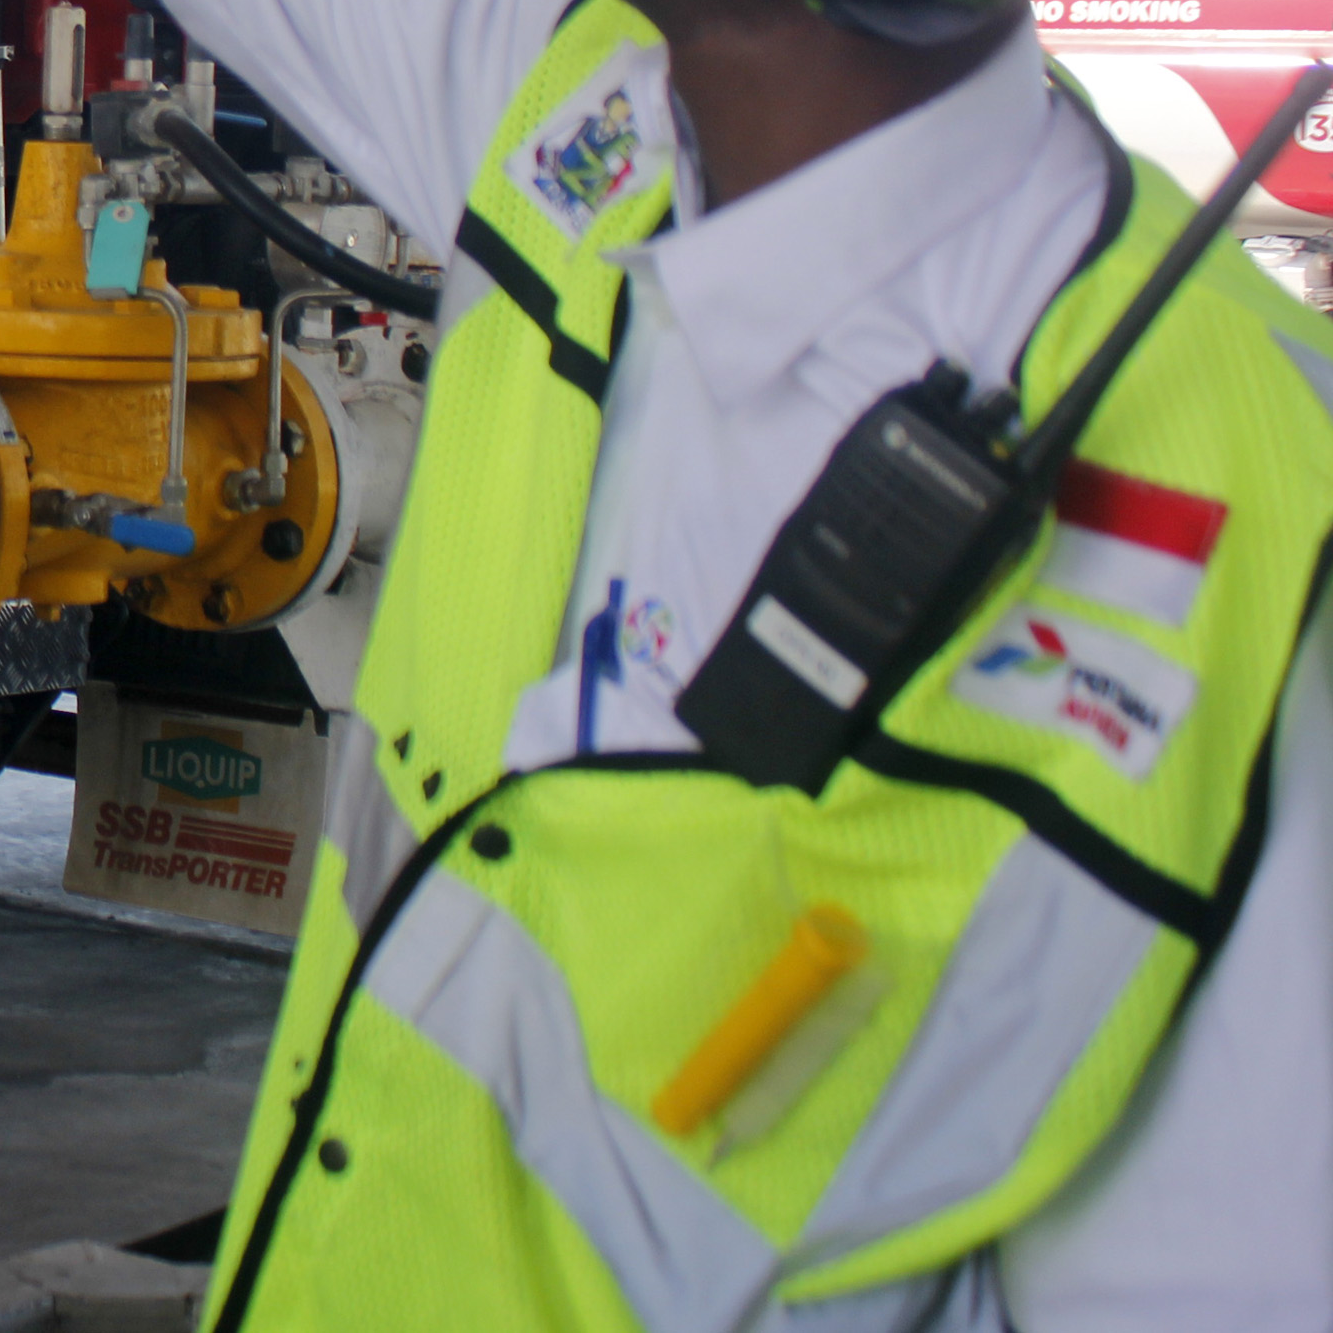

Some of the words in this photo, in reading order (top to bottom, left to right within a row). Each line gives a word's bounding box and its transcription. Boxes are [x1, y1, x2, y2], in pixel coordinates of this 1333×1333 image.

[1031, 0, 1064, 23] NO
[1069, 0, 1201, 23] SMOKING
[1300, 113, 1333, 141] 13
[149, 745, 257, 790] LIQUIP
[95, 799, 173, 847] SSB
[93, 839, 288, 899] TransPORTER
